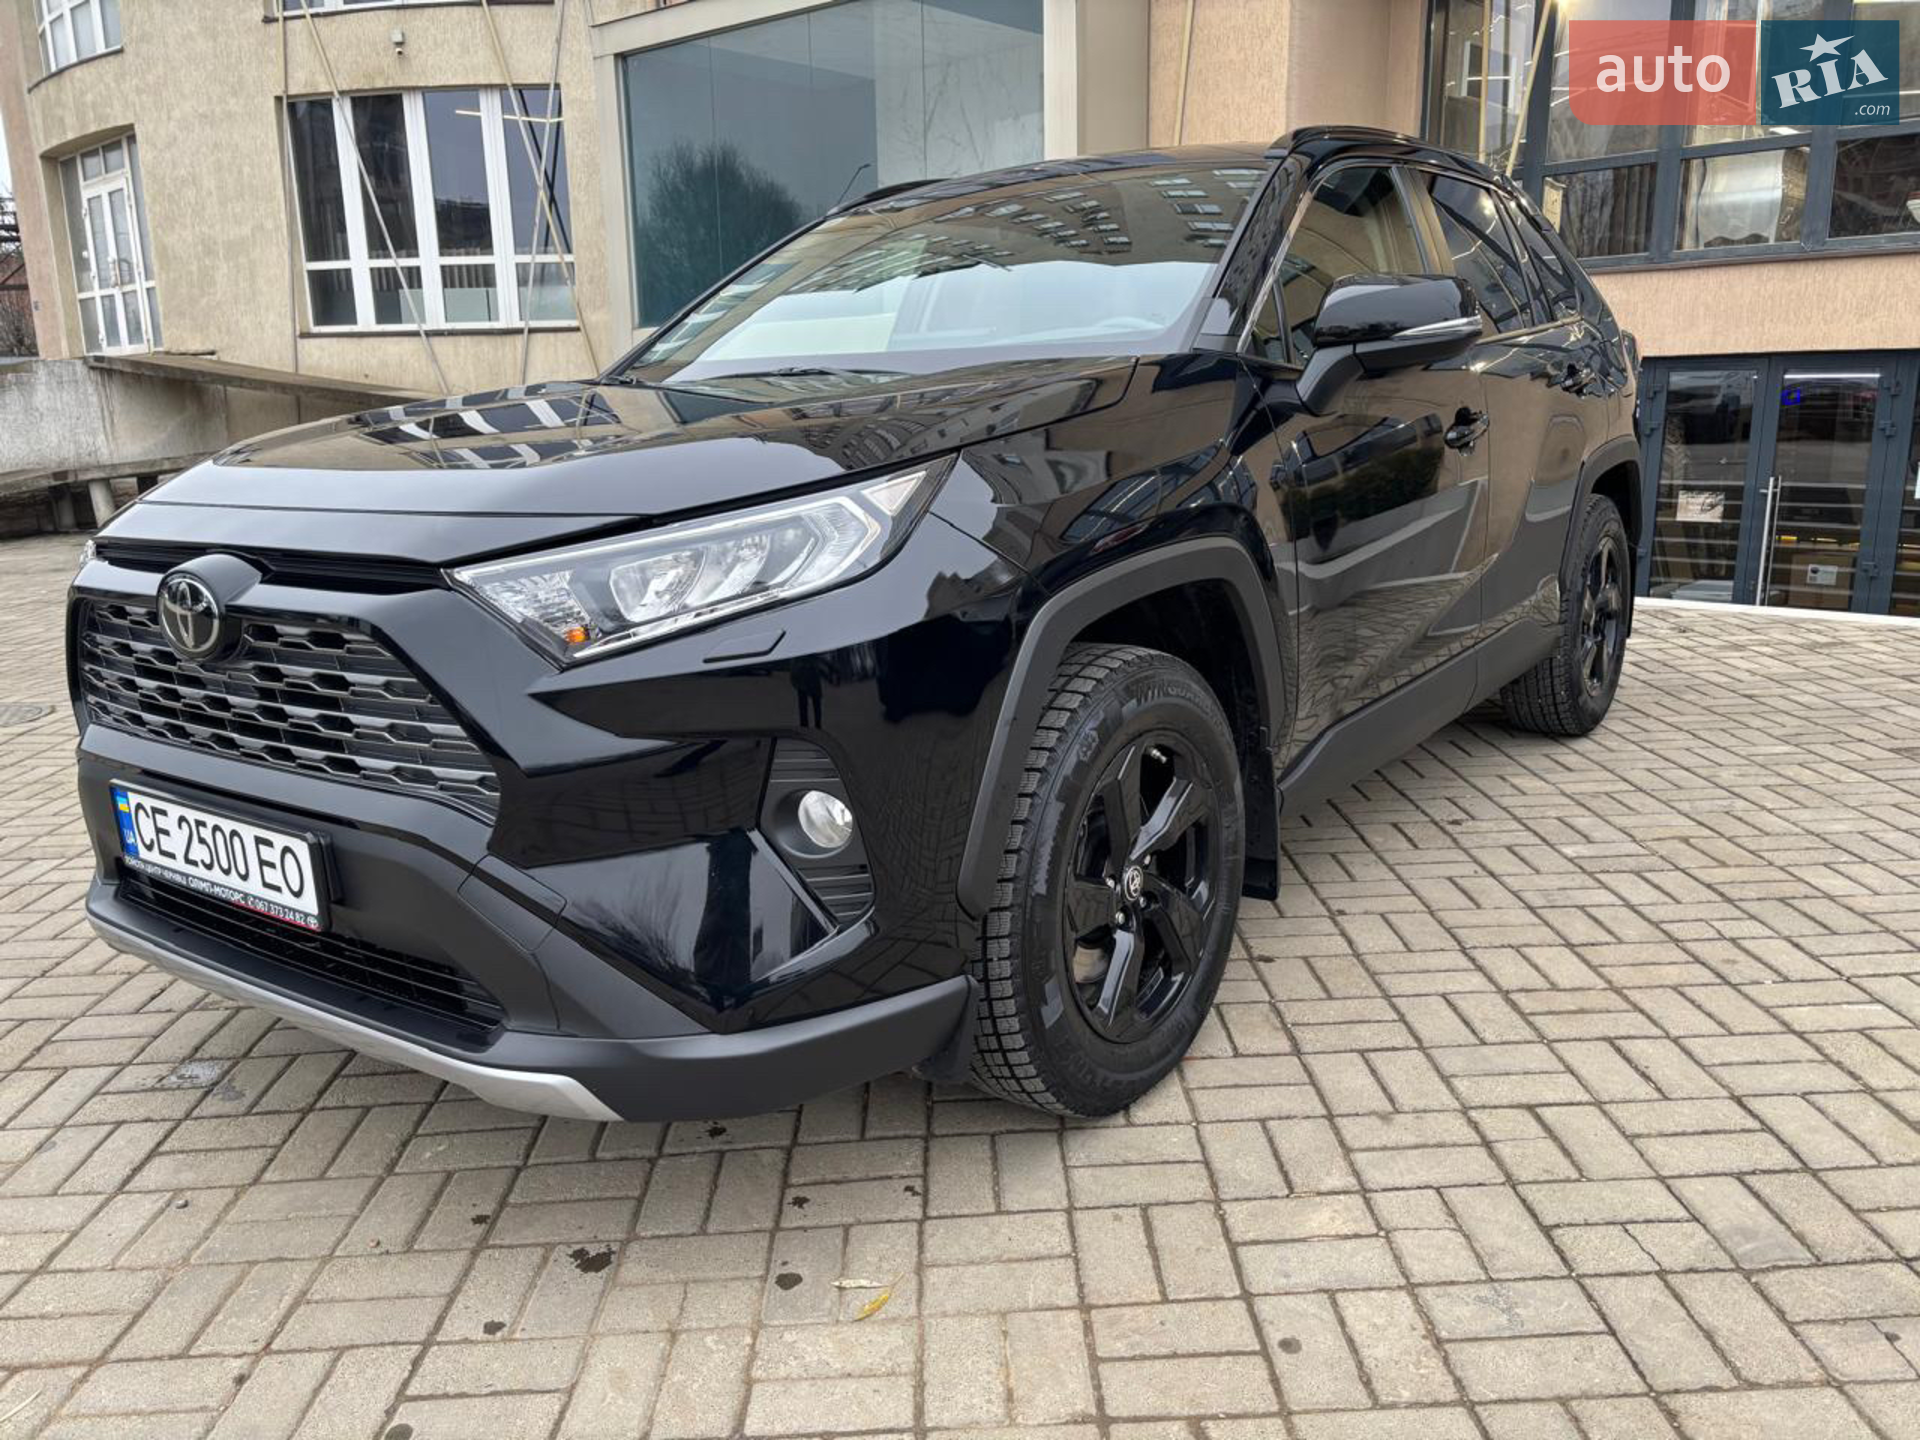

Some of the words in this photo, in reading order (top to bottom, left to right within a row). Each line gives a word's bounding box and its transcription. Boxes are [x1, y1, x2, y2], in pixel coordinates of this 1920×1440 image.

[123, 828, 137, 844] UA
[134, 801, 177, 860] CE
[177, 814, 250, 882] 2500
[253, 834, 305, 899] EO
[188, 876, 245, 905] ОЛІМП-МОТОРС
[256, 900, 268, 913] 067
[269, 904, 283, 918] 373
[284, 908, 295, 921] 24
[295, 912, 306, 925] 82
